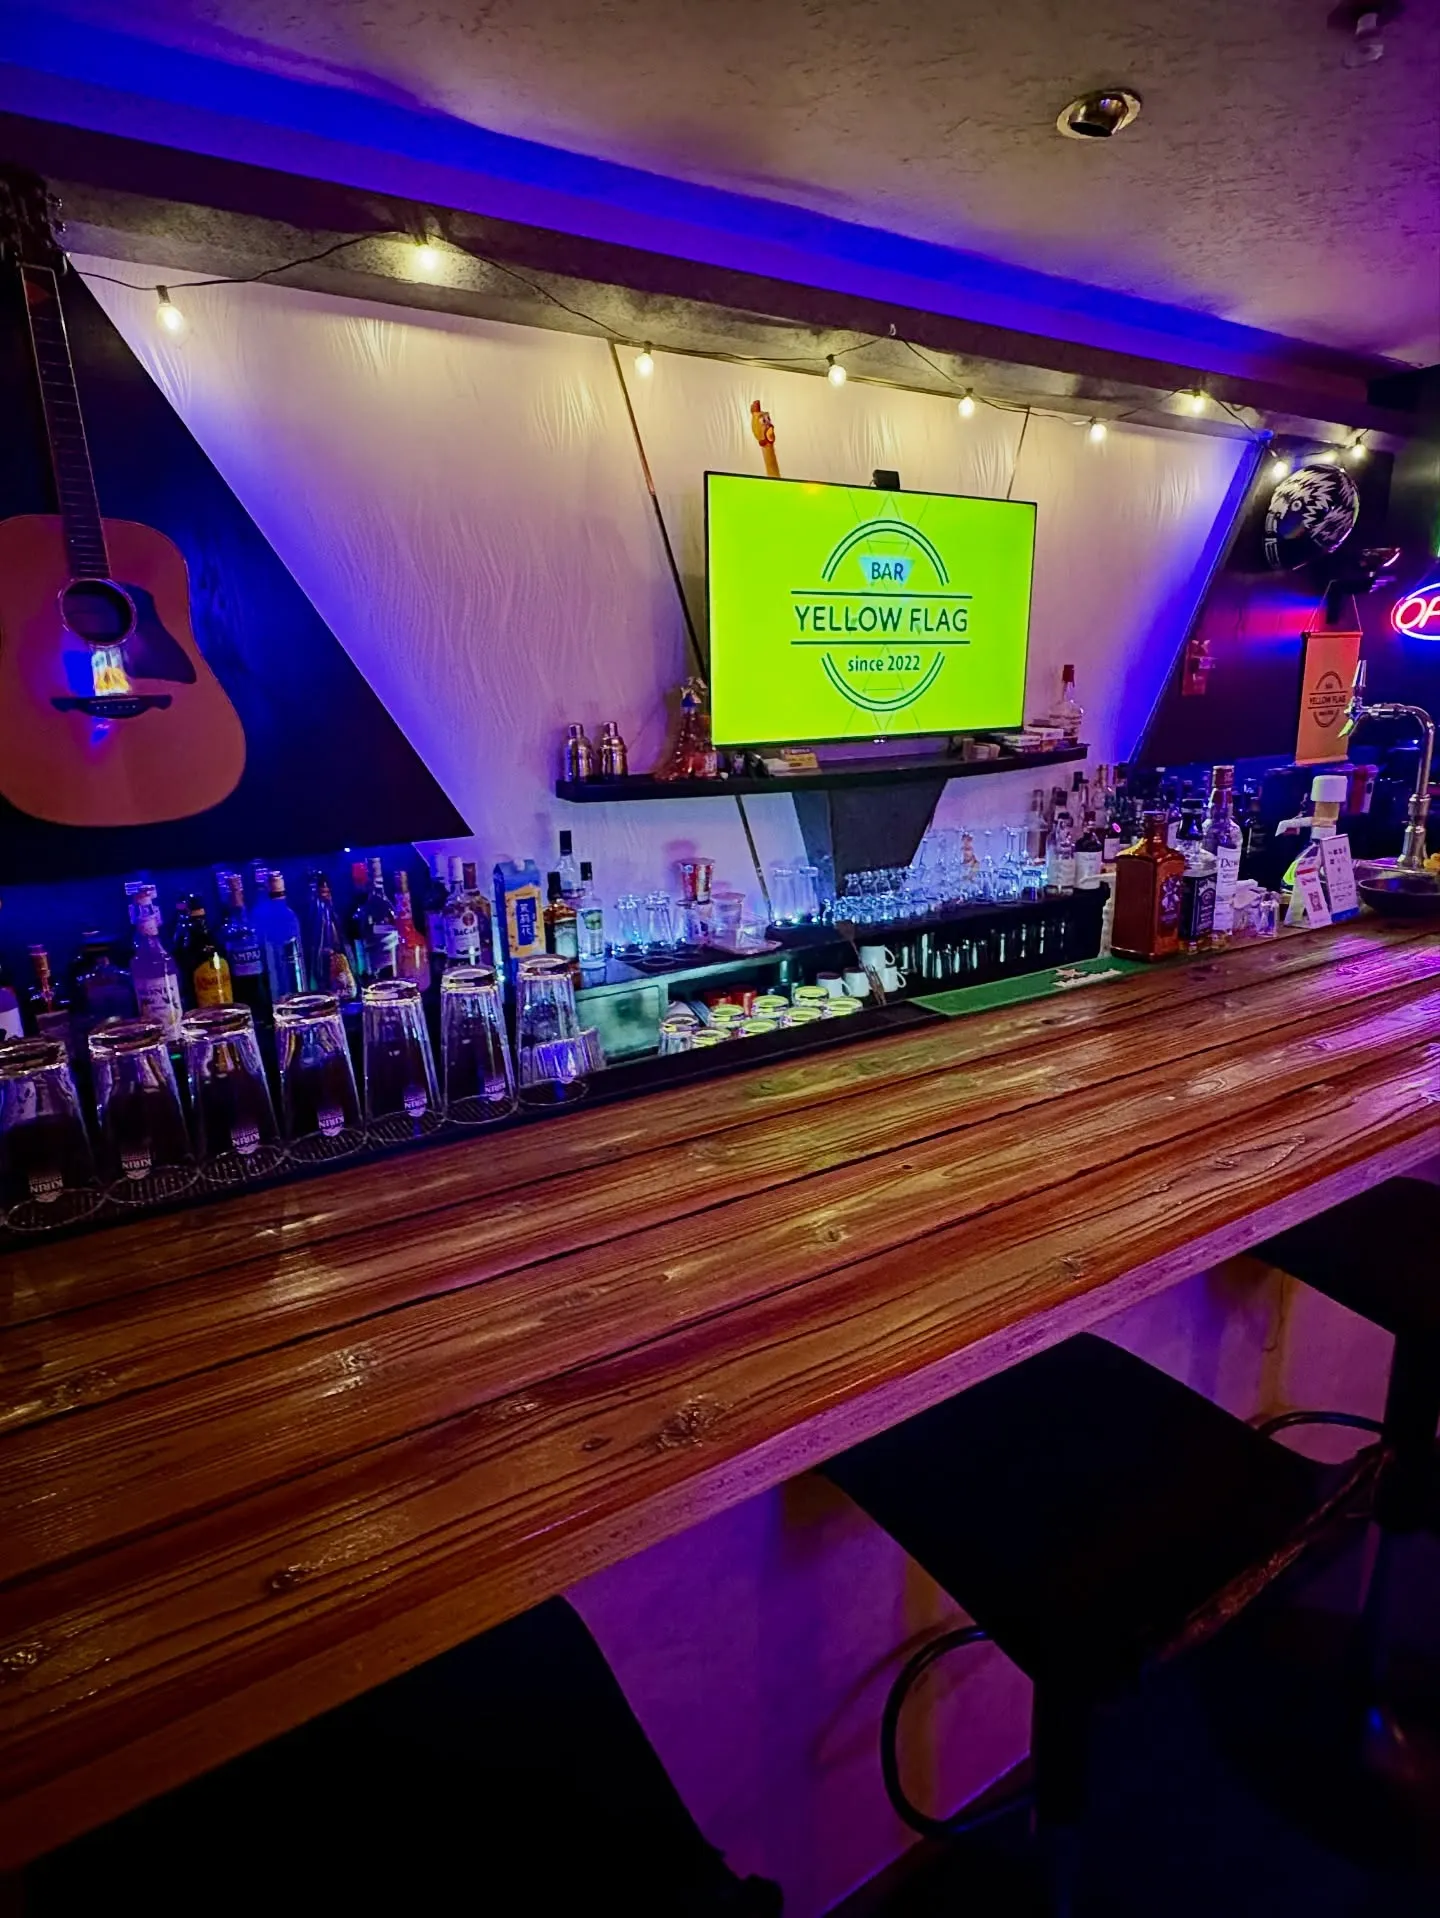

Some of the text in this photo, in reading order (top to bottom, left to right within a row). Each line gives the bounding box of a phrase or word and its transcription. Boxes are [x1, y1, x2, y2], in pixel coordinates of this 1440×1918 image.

[871, 562, 904, 581] BAR
[795, 605, 968, 632] YELLOW FLAG
[848, 655, 920, 672] since 2022
[319, 1115, 345, 1129] KIRIN
[232, 1132, 260, 1146] KIRIN
[121, 1157, 152, 1170] KIRIN
[29, 1178, 64, 1194] KIRIN
